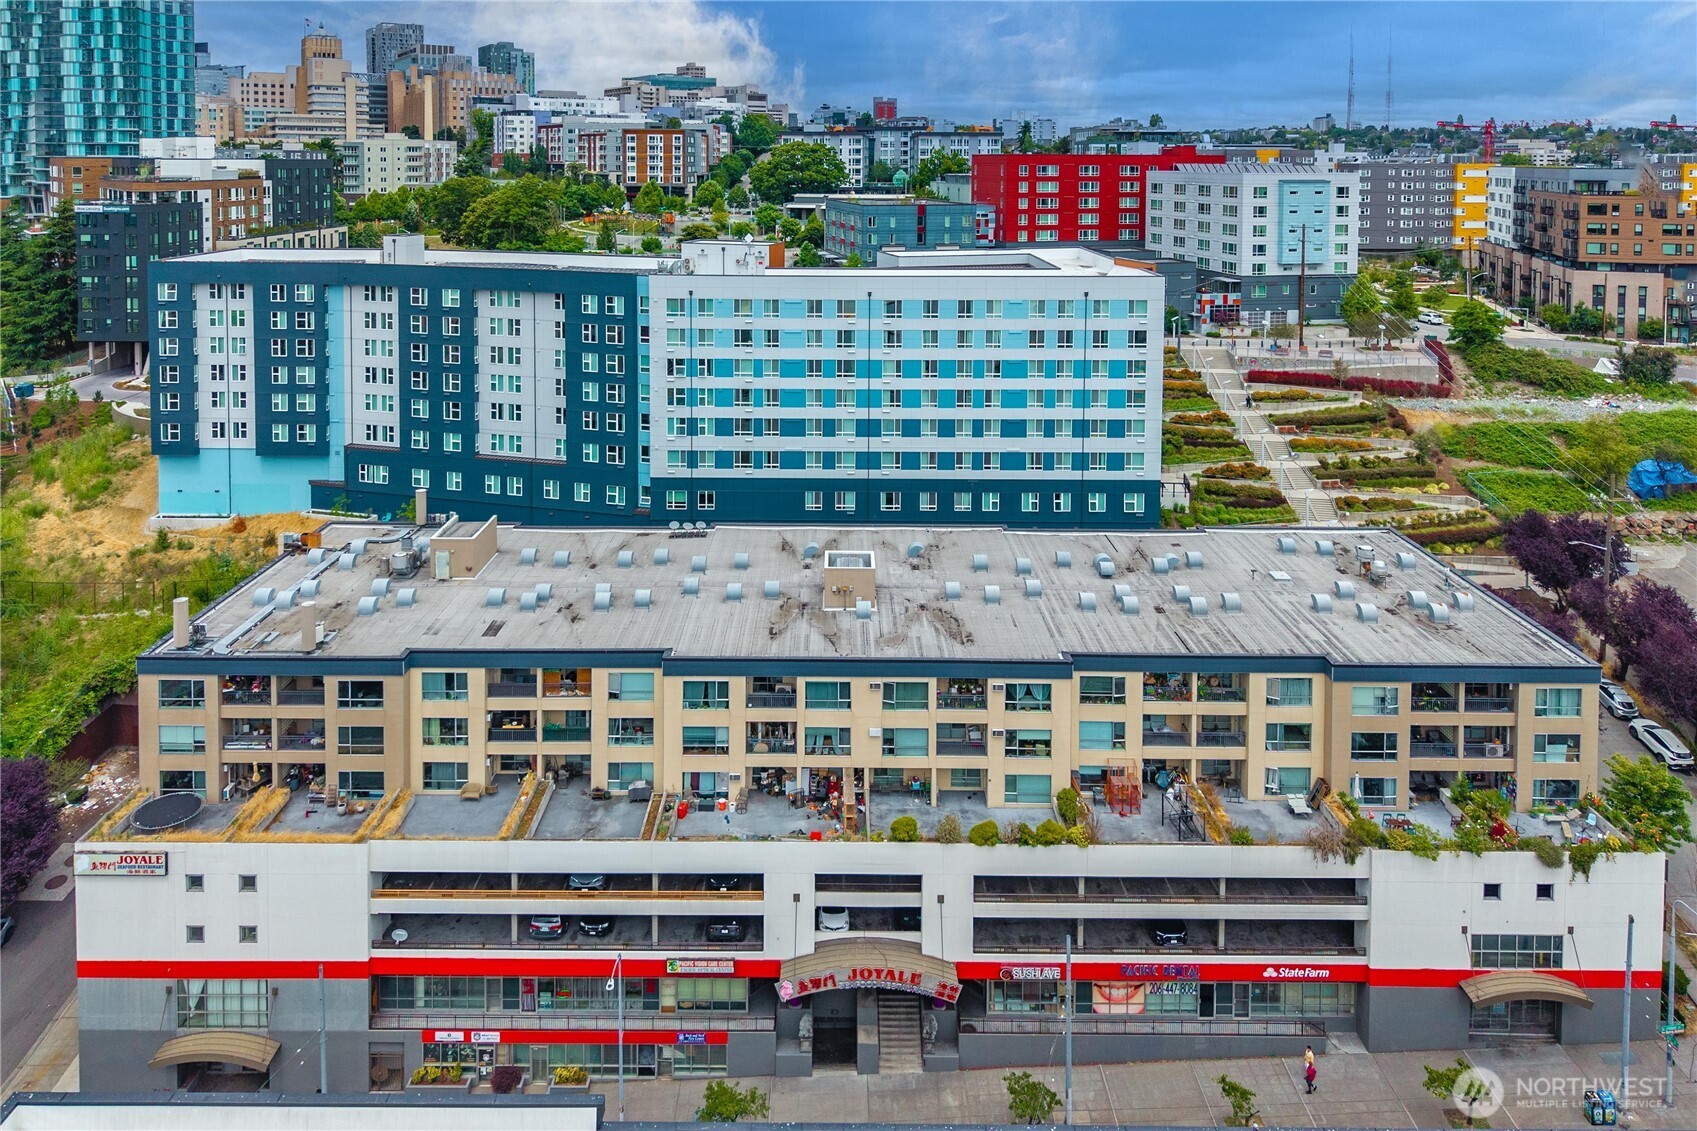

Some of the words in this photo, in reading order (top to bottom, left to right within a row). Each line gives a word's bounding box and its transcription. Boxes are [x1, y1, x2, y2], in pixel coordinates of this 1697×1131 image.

[117, 855, 164, 865] JOYALE
[848, 967, 922, 986] JOYALE
[1012, 967, 1042, 979] SUSHI
[1042, 967, 1061, 979] AVE
[1121, 964, 1158, 976] PACIFIC
[1162, 964, 1200, 977] DENTAL
[838, 980, 878, 989] SEAFOOD
[880, 980, 935, 998] RESTAURANT
[1149, 982, 1198, 994] 206-447-8084
